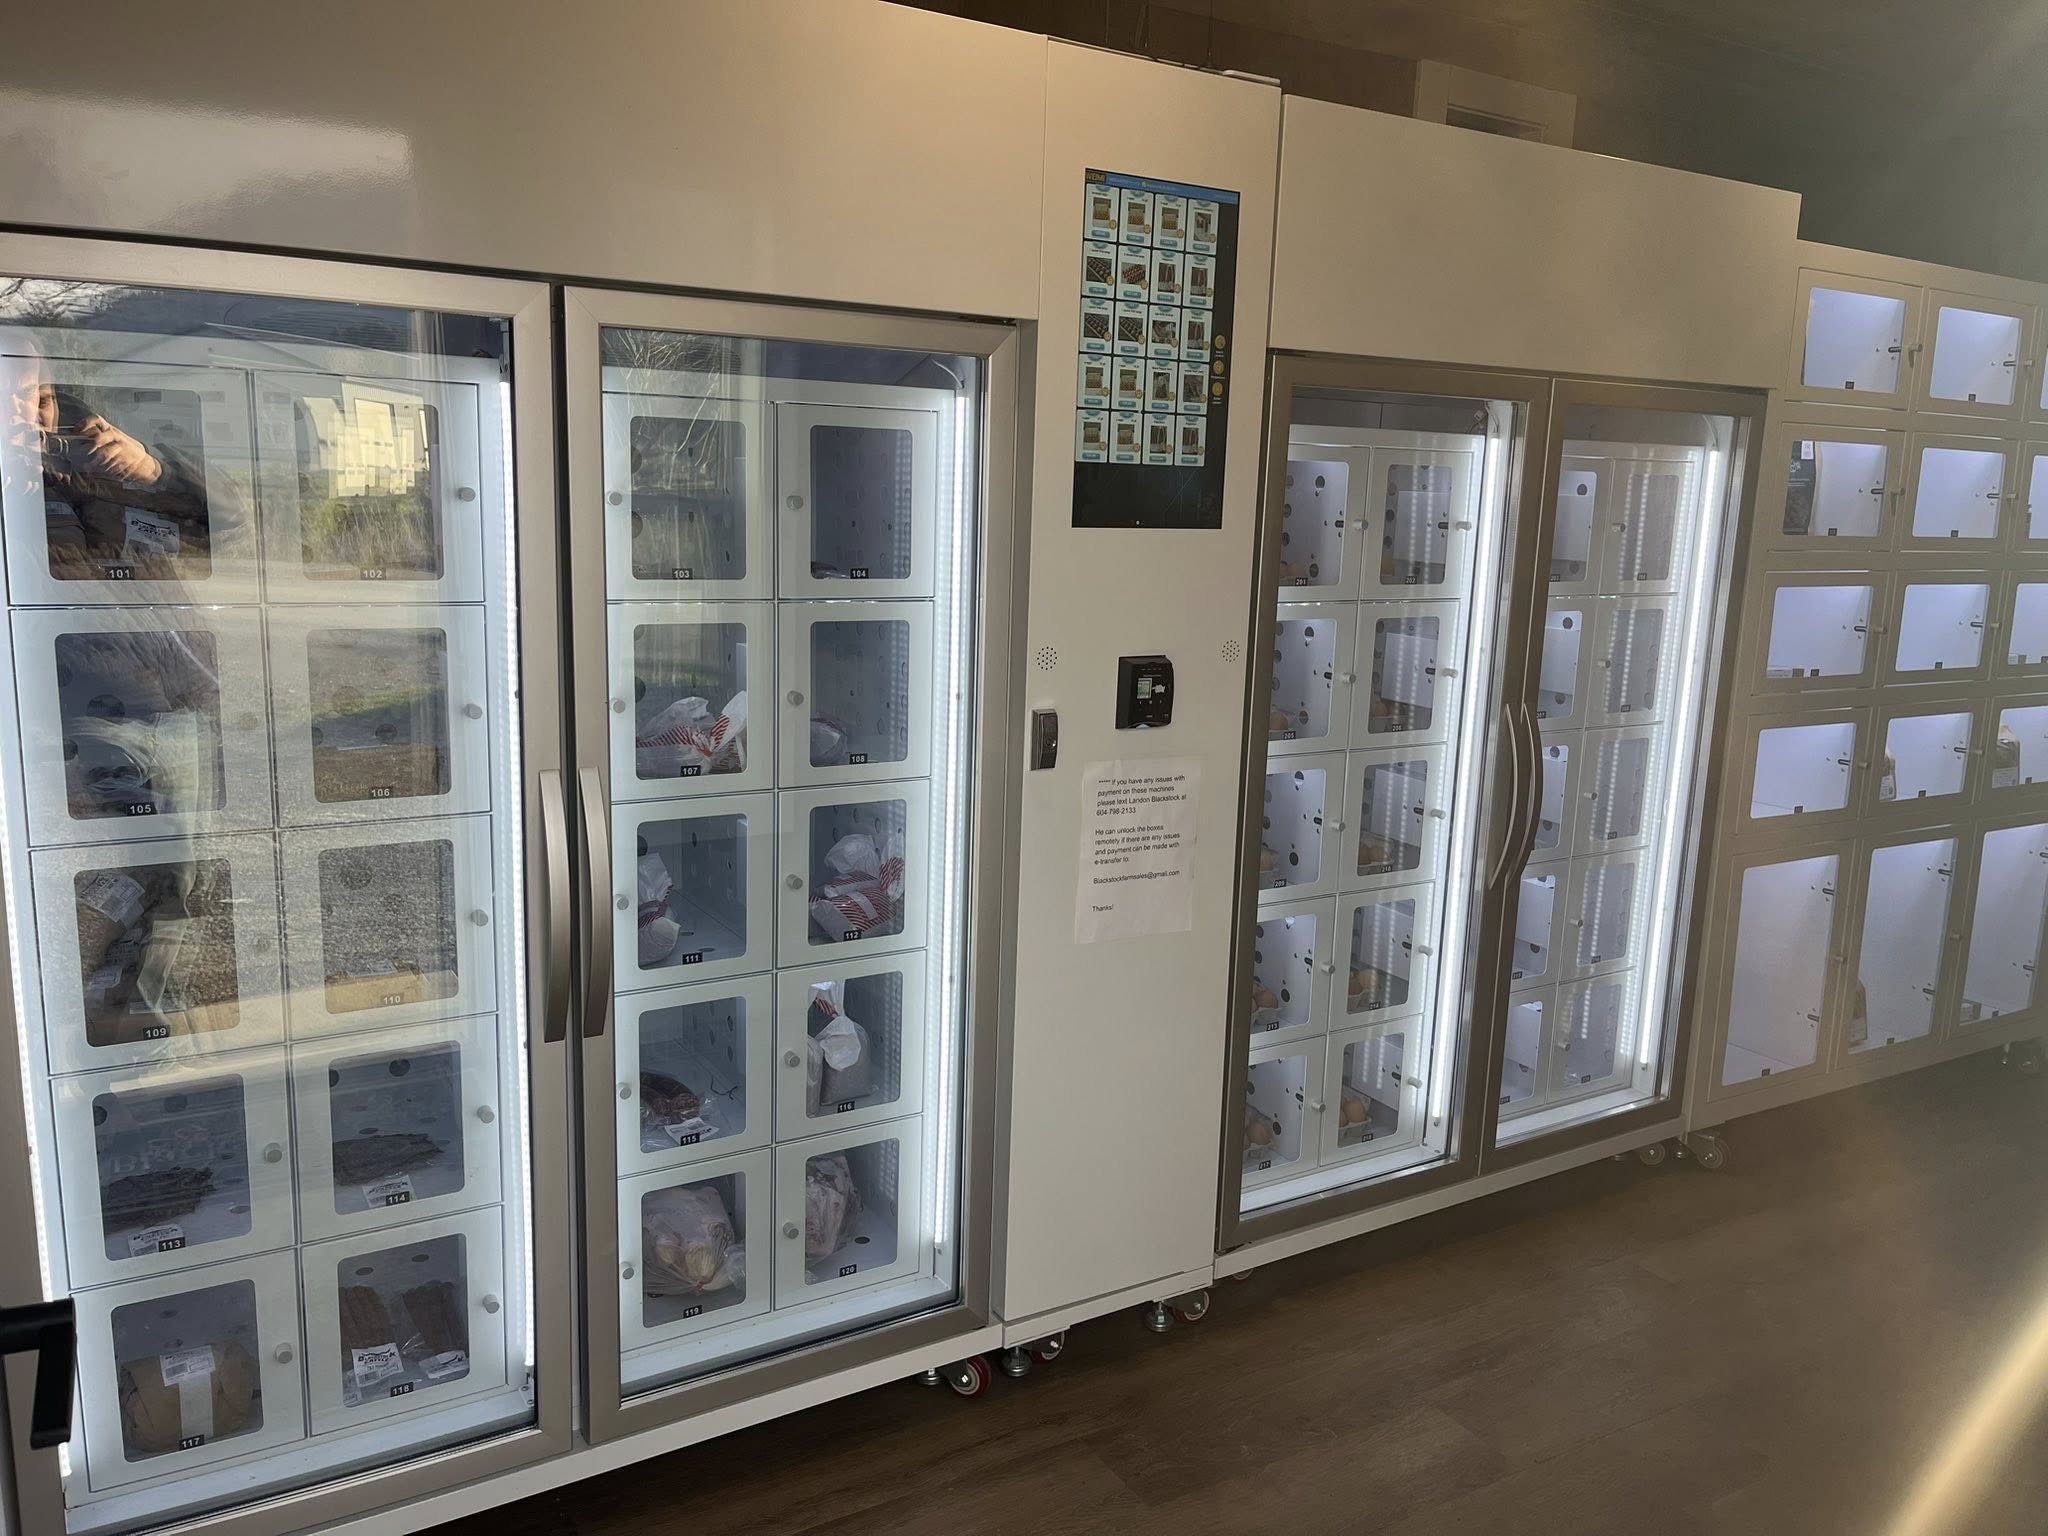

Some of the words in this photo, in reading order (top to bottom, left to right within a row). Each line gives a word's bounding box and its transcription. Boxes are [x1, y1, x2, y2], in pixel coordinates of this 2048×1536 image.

[109, 569, 130, 579] 101
[363, 570, 383, 579] 102
[673, 570, 690, 578] 103
[852, 570, 866, 578] 104
[851, 755, 865, 763] 108
[683, 767, 698, 775] 107
[371, 788, 390, 797] 106
[1097, 789, 1122, 797] payment
[1097, 799, 1116, 807] please
[1151, 794, 1180, 803] Blackstock
[130, 804, 152, 814] 105
[1107, 846, 1132, 855] payment
[845, 931, 859, 940] 112
[685, 954, 699, 963] 111
[383, 995, 401, 1004] 110
[145, 1027, 167, 1038] 109
[839, 1102, 852, 1111] 116
[682, 1135, 697, 1144] 115
[389, 1194, 406, 1204] 114
[162, 1240, 181, 1250] 113
[841, 1266, 855, 1275] 120
[685, 1307, 699, 1317] 119
[393, 1384, 410, 1395] 118
[181, 1437, 201, 1448] 117
